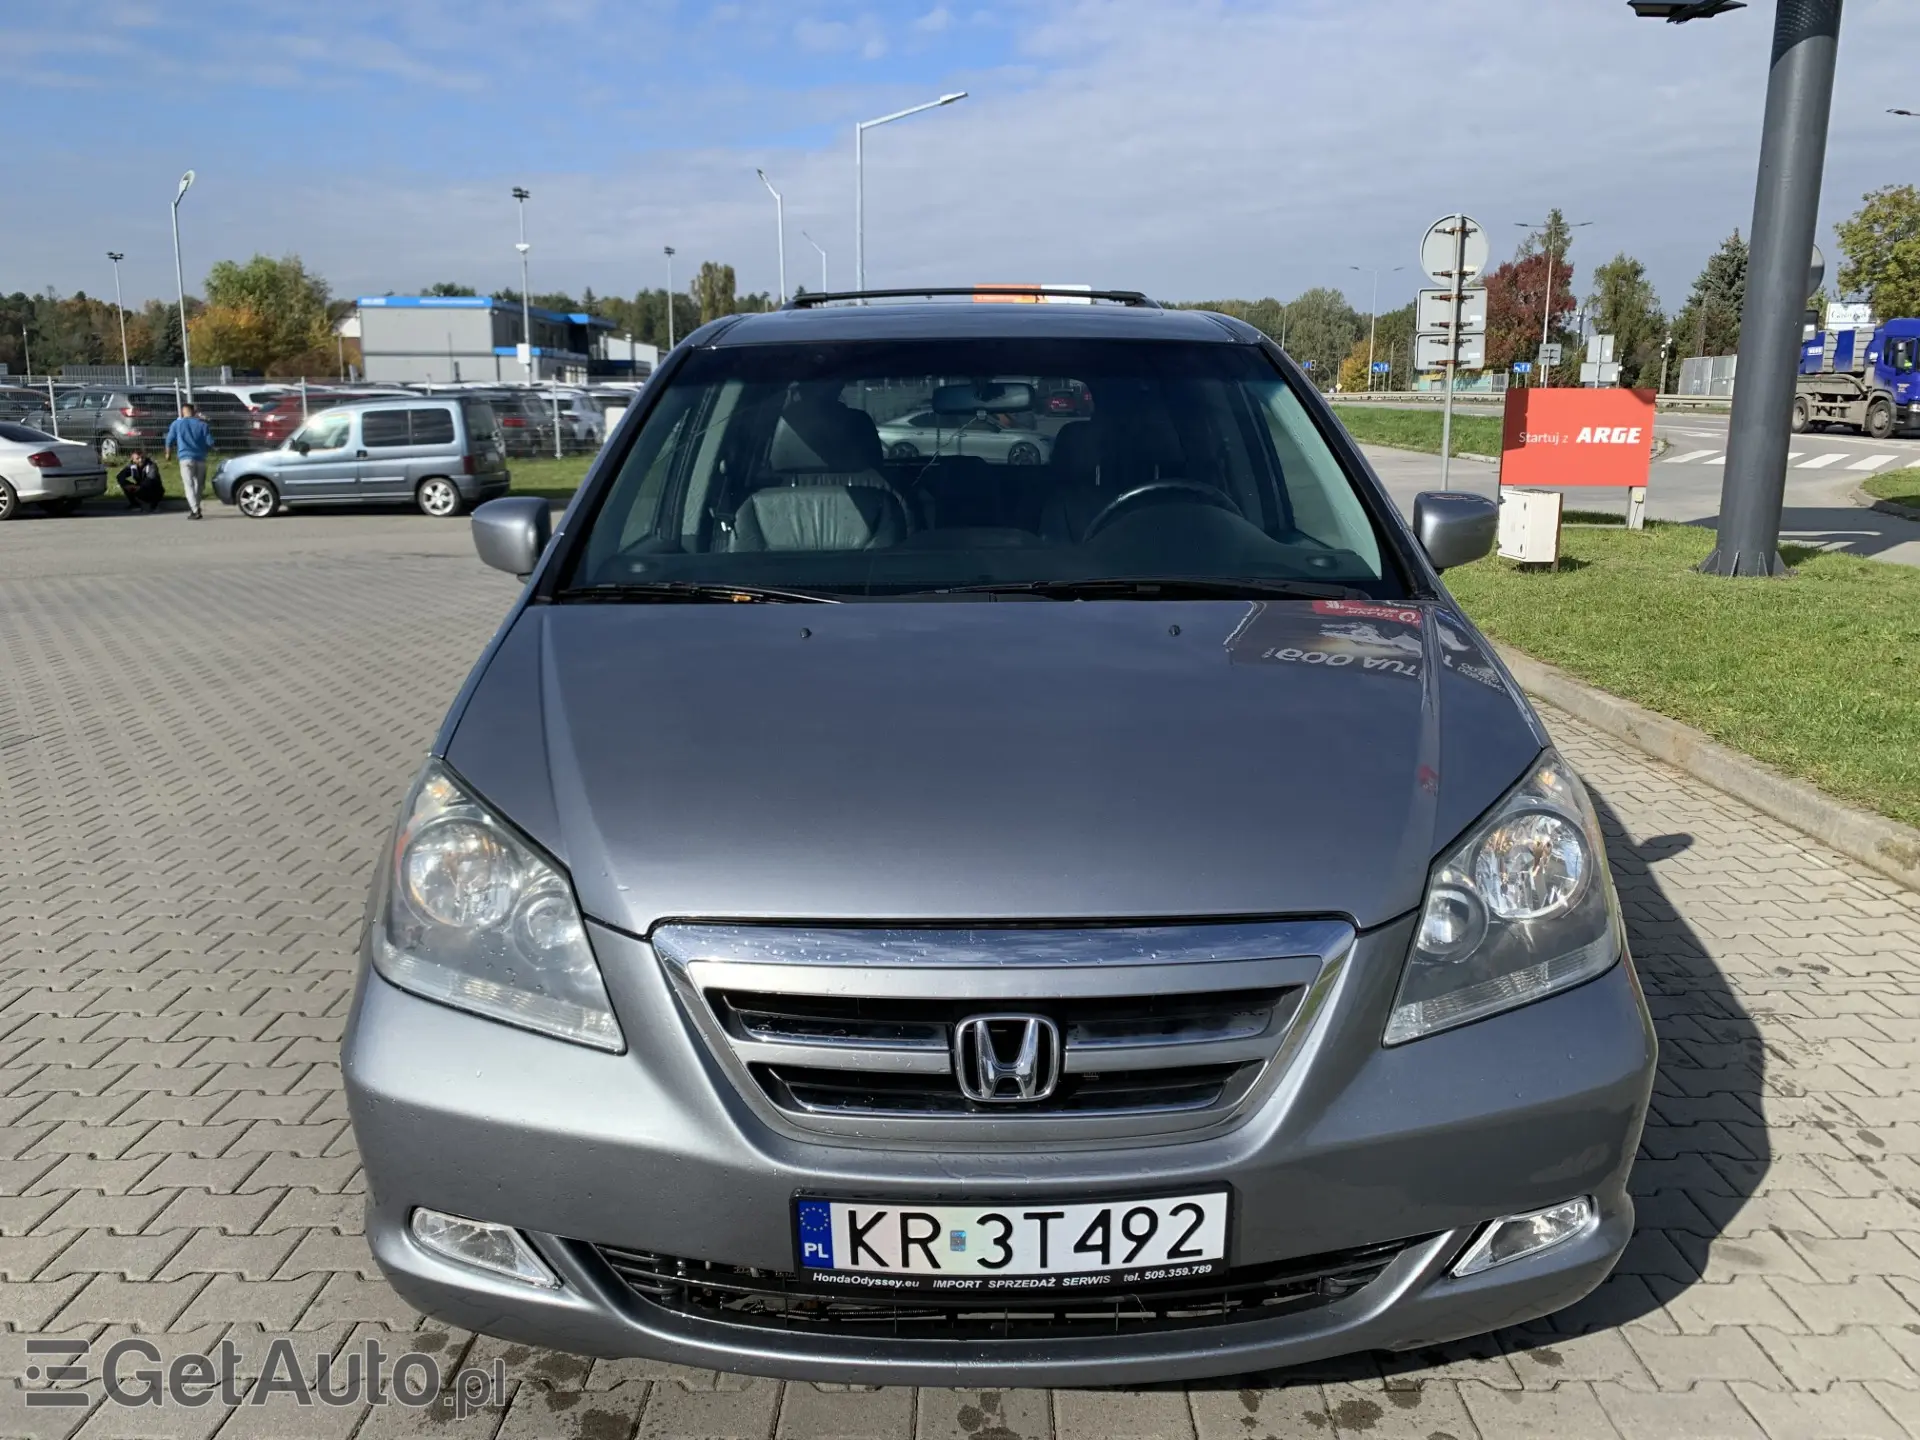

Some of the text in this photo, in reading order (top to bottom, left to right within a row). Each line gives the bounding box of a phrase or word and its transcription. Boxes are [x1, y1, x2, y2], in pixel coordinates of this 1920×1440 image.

[1518, 427, 1642, 445] Startuj z ARGE
[847, 1202, 1205, 1269] KR 3T492
[803, 1242, 829, 1259] PL
[812, 1264, 1212, 1289] HondaOdyssey.eu IMPORT SPRZEDAŻ SERWIS tel. 509.359.789
